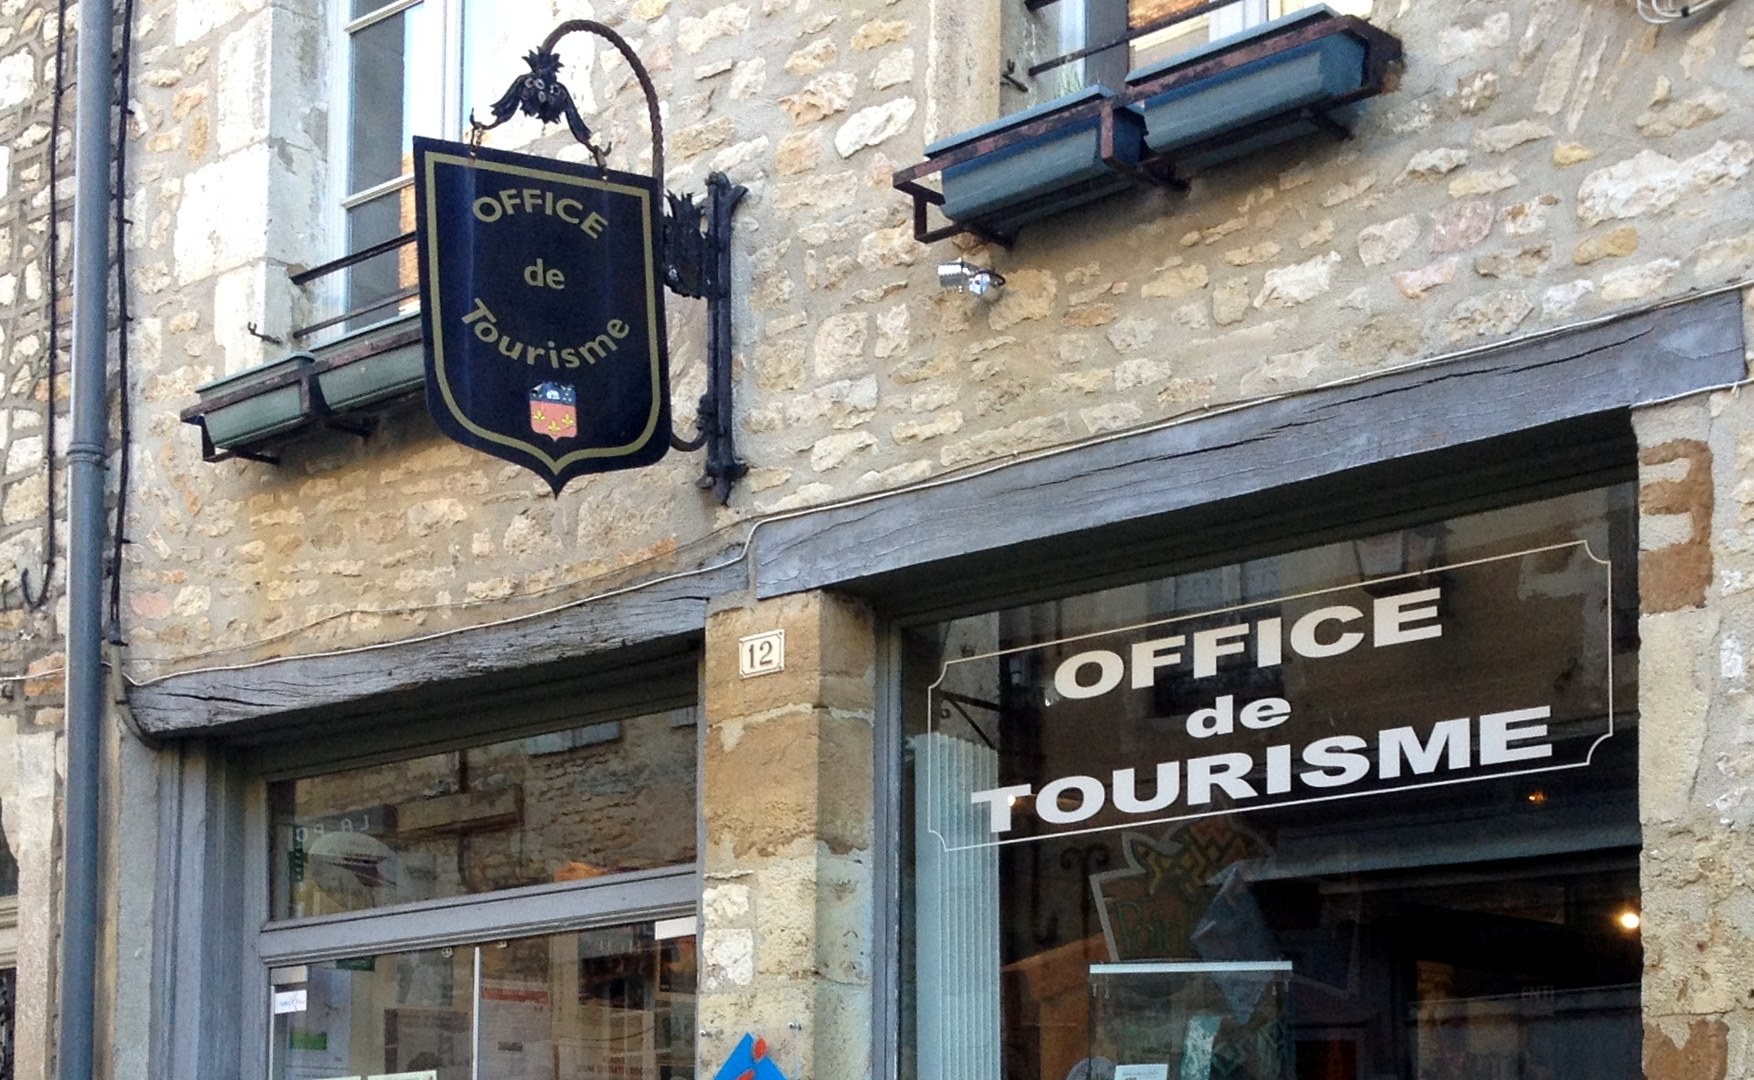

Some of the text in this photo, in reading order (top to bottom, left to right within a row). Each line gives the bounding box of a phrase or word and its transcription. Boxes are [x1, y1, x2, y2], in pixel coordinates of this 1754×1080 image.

[473, 188, 609, 240] OFFICE
[523, 258, 565, 289] de
[461, 298, 630, 369] Tourisme
[748, 640, 773, 668] 12
[1053, 587, 1443, 700] OFFICE
[1185, 695, 1292, 739] de
[970, 704, 1553, 834] TOURISME
